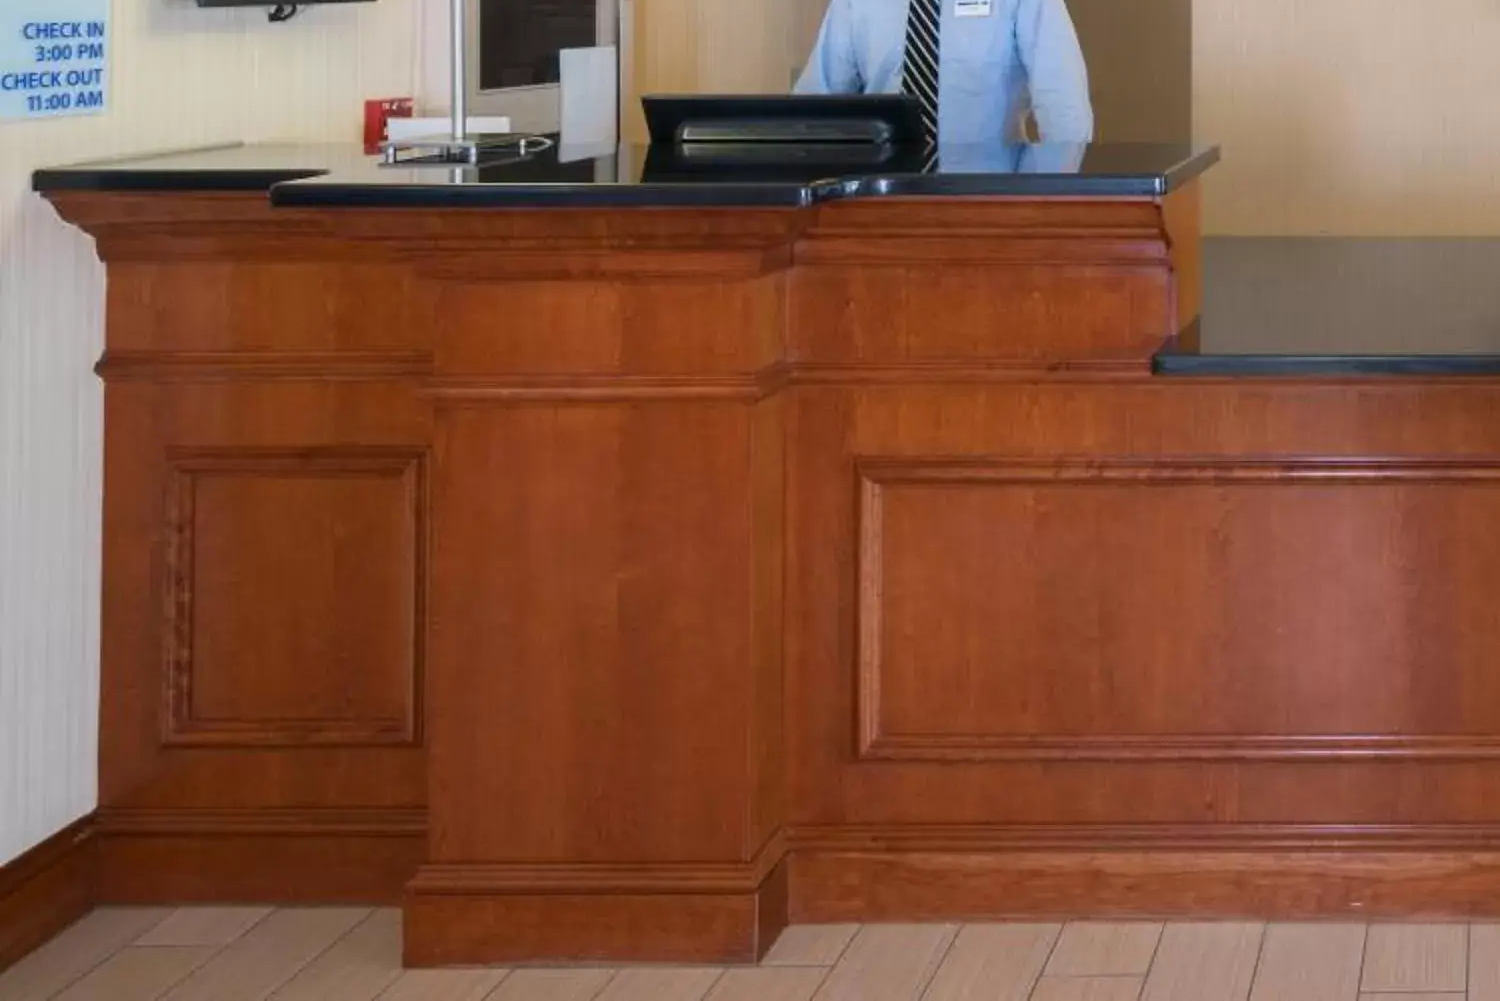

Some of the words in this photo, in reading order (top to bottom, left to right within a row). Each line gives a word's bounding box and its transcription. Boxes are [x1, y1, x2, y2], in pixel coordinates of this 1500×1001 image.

[23, 22, 81, 39] CHECK
[87, 22, 104, 38] IN
[34, 44, 72, 61] 3:00
[78, 43, 104, 59] PM
[1, 71, 62, 90] CHECK
[66, 68, 104, 86] OUT
[28, 93, 71, 111] 11:00
[75, 90, 103, 107] AM
